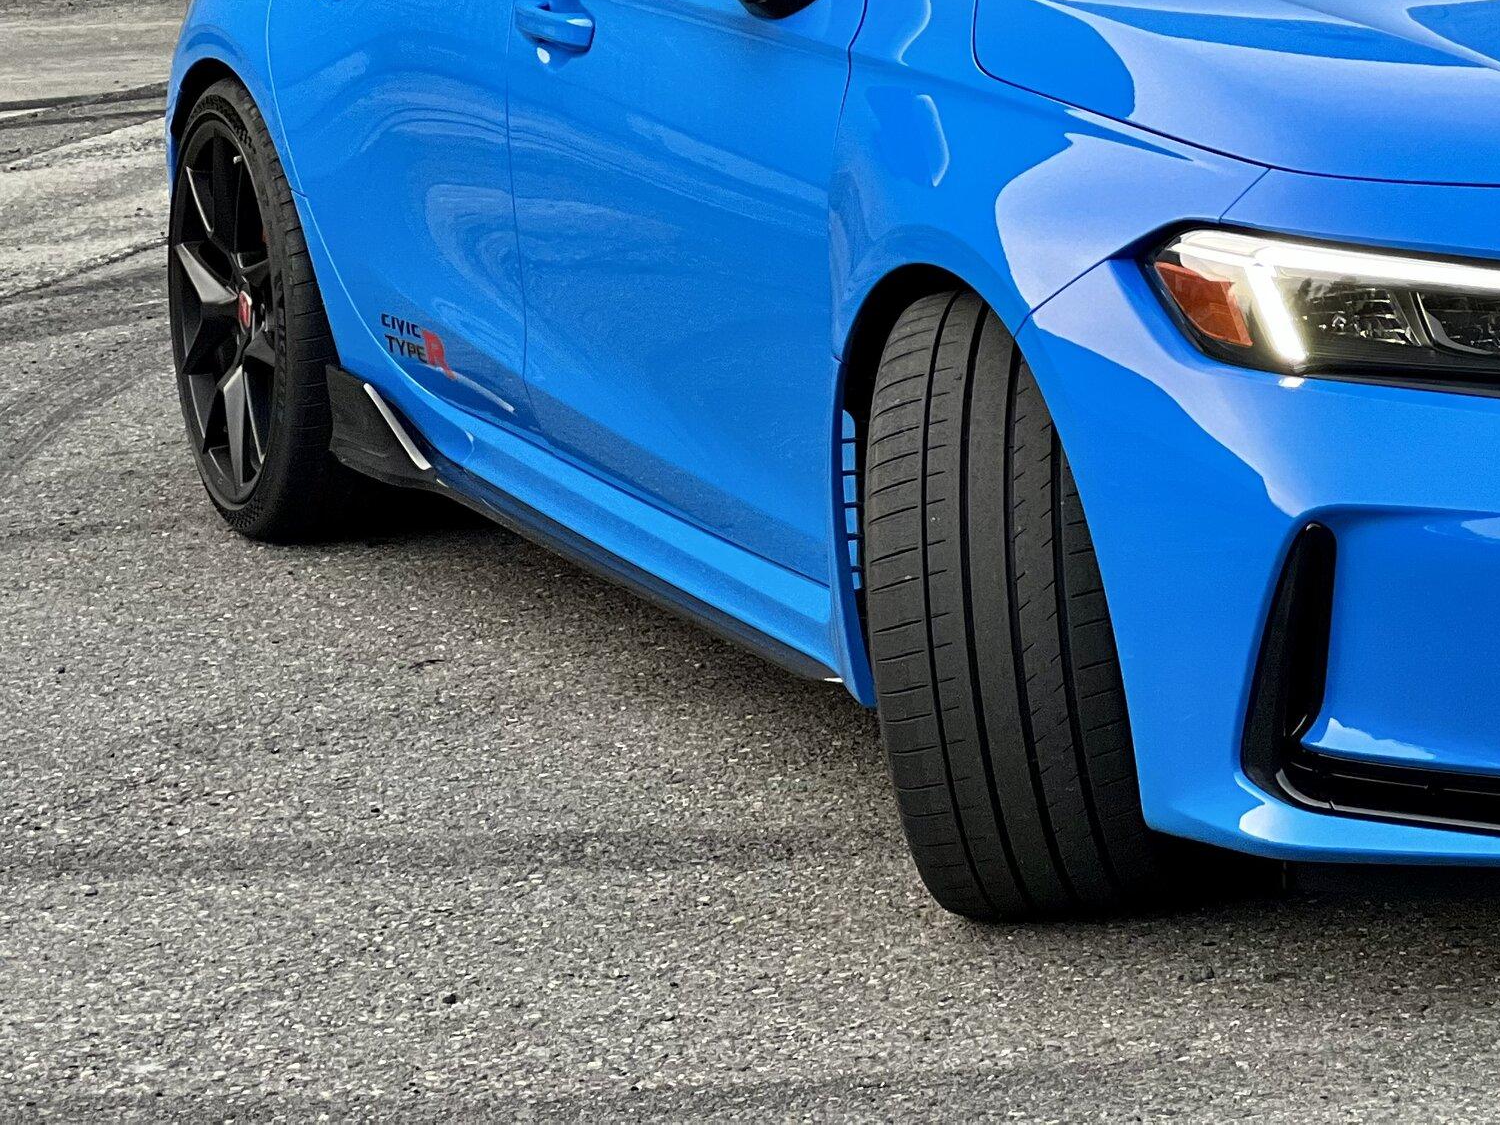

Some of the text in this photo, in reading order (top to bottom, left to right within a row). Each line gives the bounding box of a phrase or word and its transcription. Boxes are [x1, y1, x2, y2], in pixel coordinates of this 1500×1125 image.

[381, 313, 421, 338] CIVIC
[385, 329, 456, 379] TYPE R
